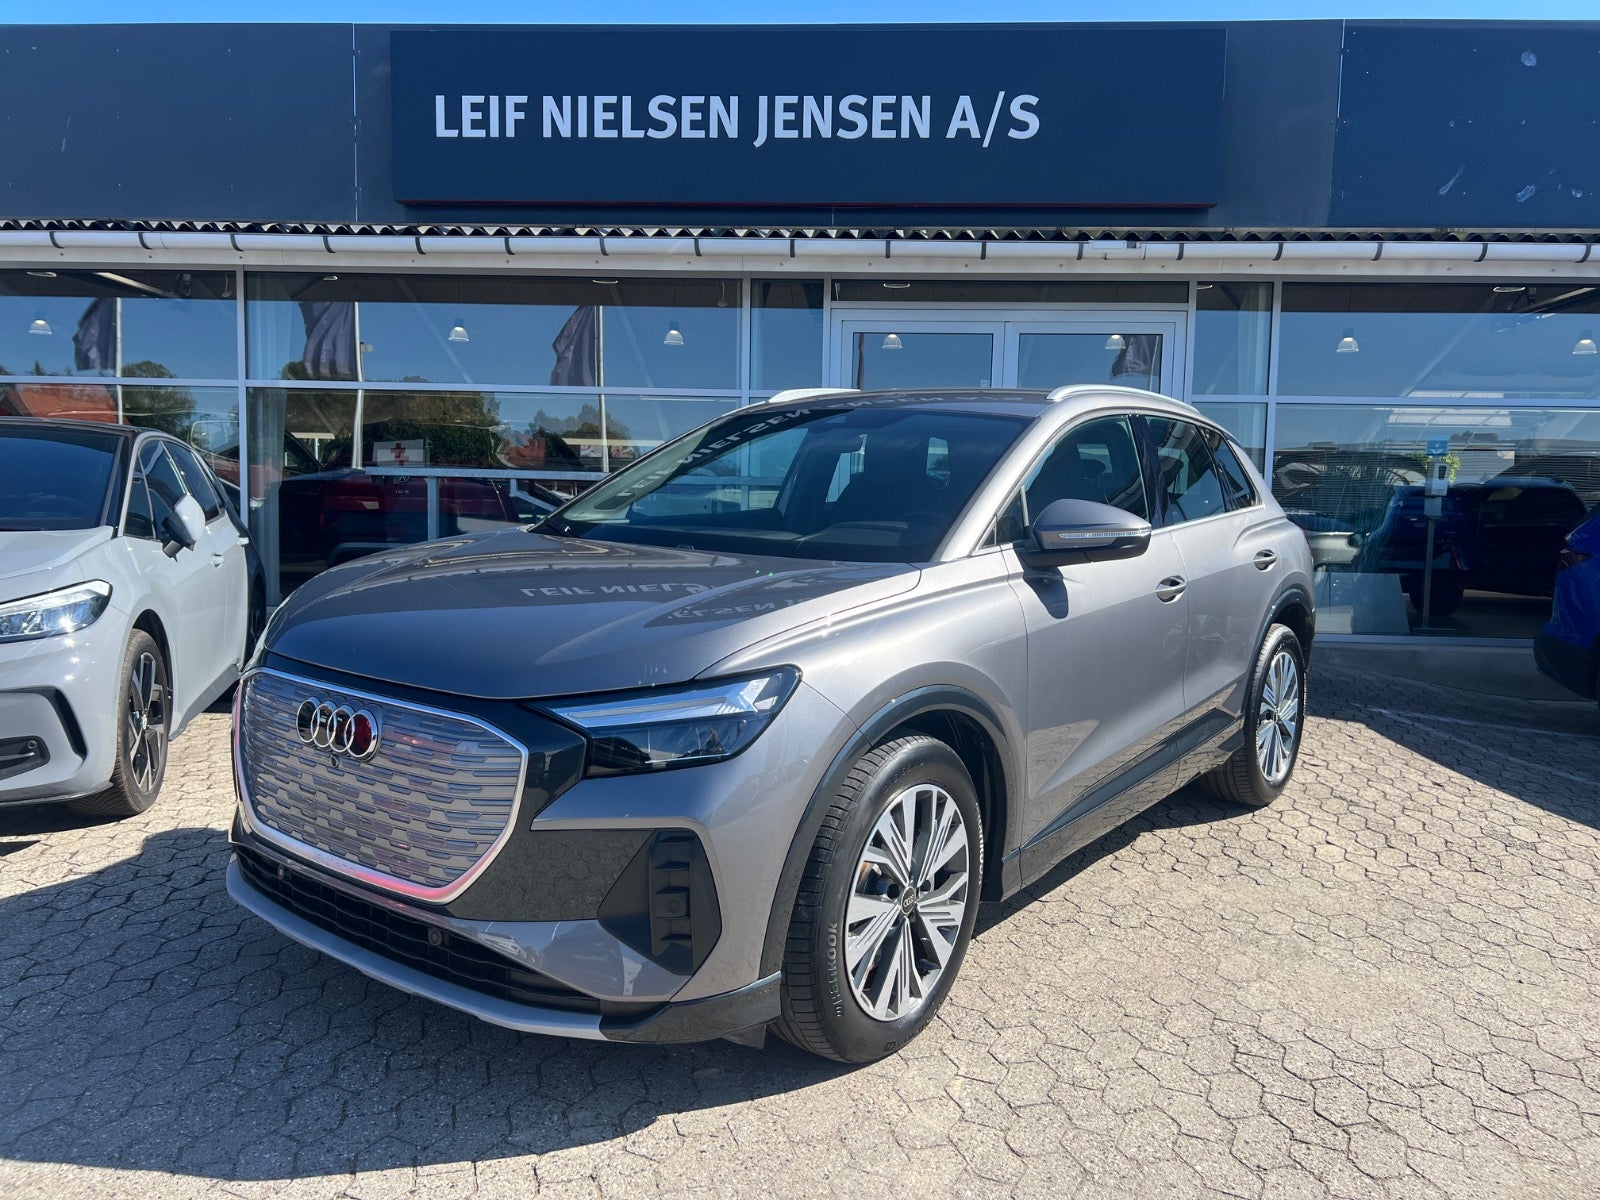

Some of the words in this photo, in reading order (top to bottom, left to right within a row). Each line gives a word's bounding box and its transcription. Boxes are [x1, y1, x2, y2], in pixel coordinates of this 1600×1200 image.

[434, 94, 528, 138] LEIF
[542, 94, 740, 139] NIELSEN
[752, 94, 932, 148] JENSEN
[945, 91, 1041, 148] A/S
